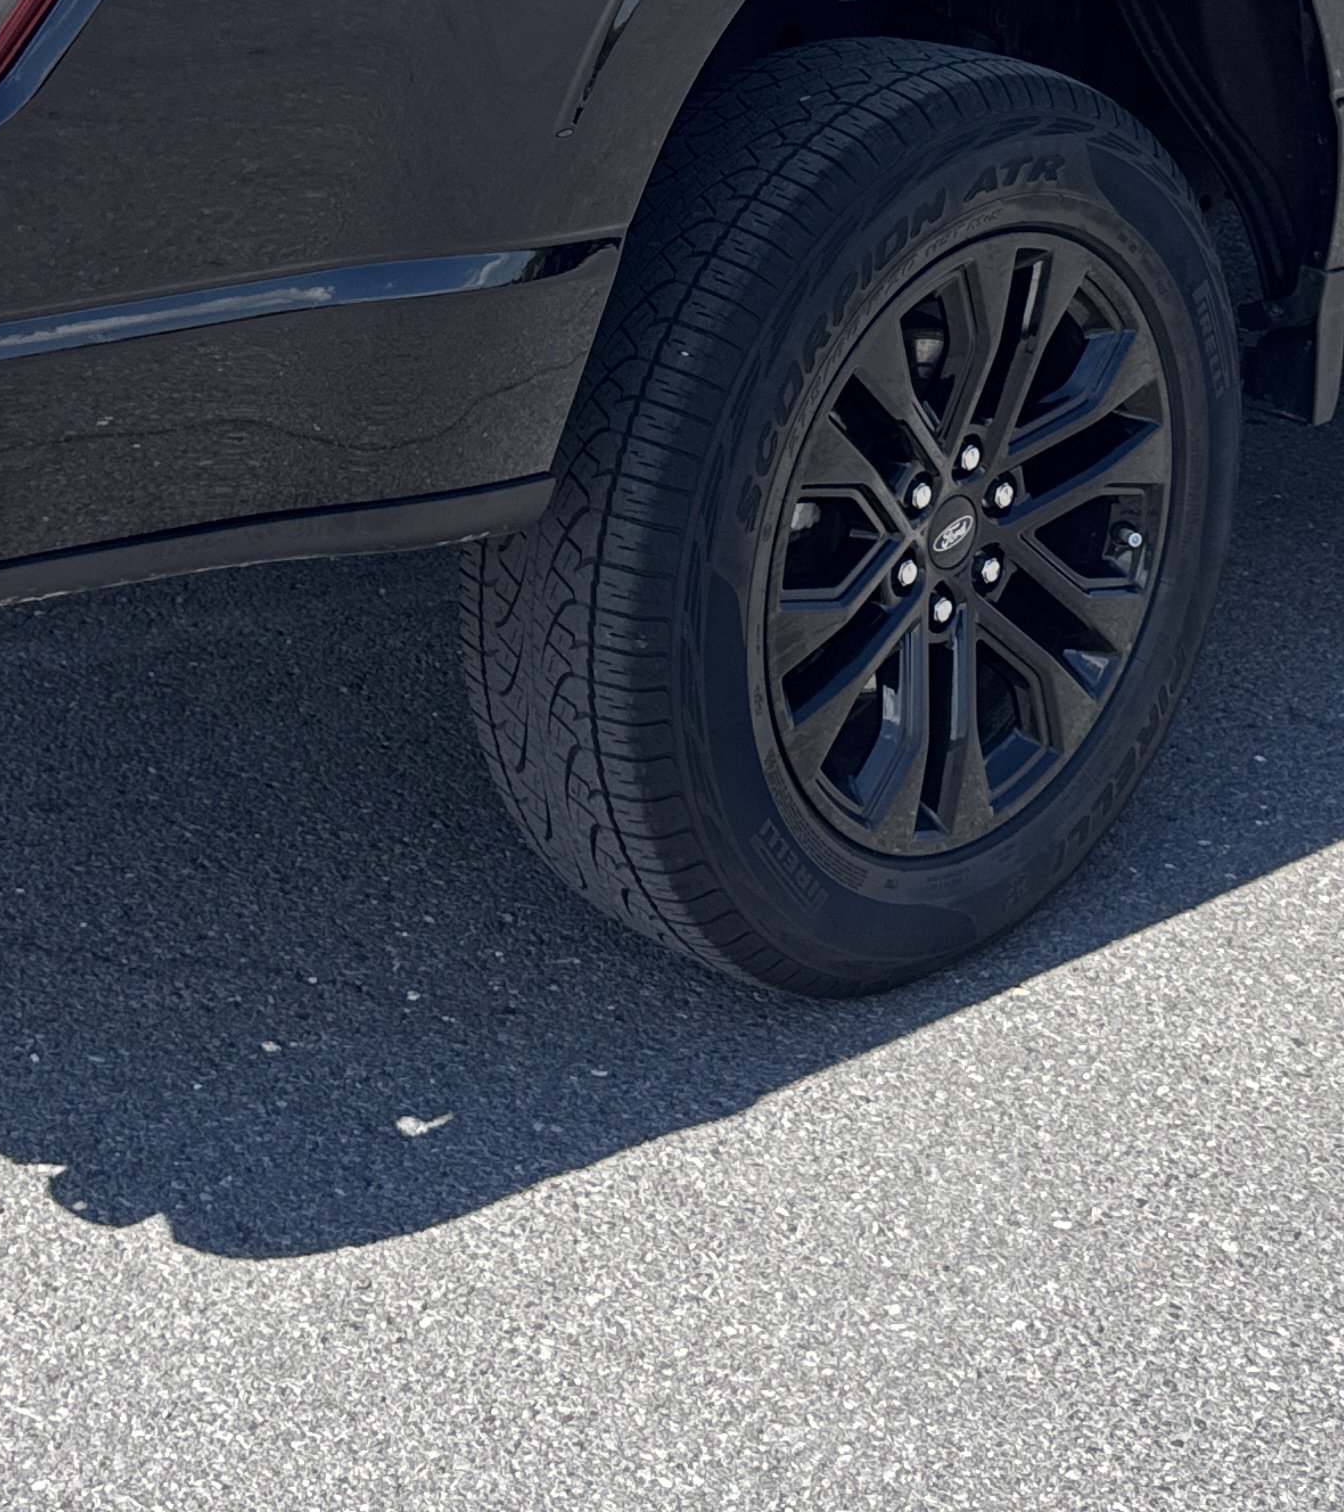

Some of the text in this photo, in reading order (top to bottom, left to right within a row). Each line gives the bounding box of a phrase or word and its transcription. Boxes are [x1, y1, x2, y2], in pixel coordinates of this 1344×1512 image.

[736, 186, 947, 533] SCORPION
[963, 153, 1067, 202] ATR
[1191, 278, 1231, 399] PIRELLI
[940, 519, 968, 549] Ford
[1051, 643, 1187, 875] PIRELLI
[749, 817, 829, 918] PIRELLI
